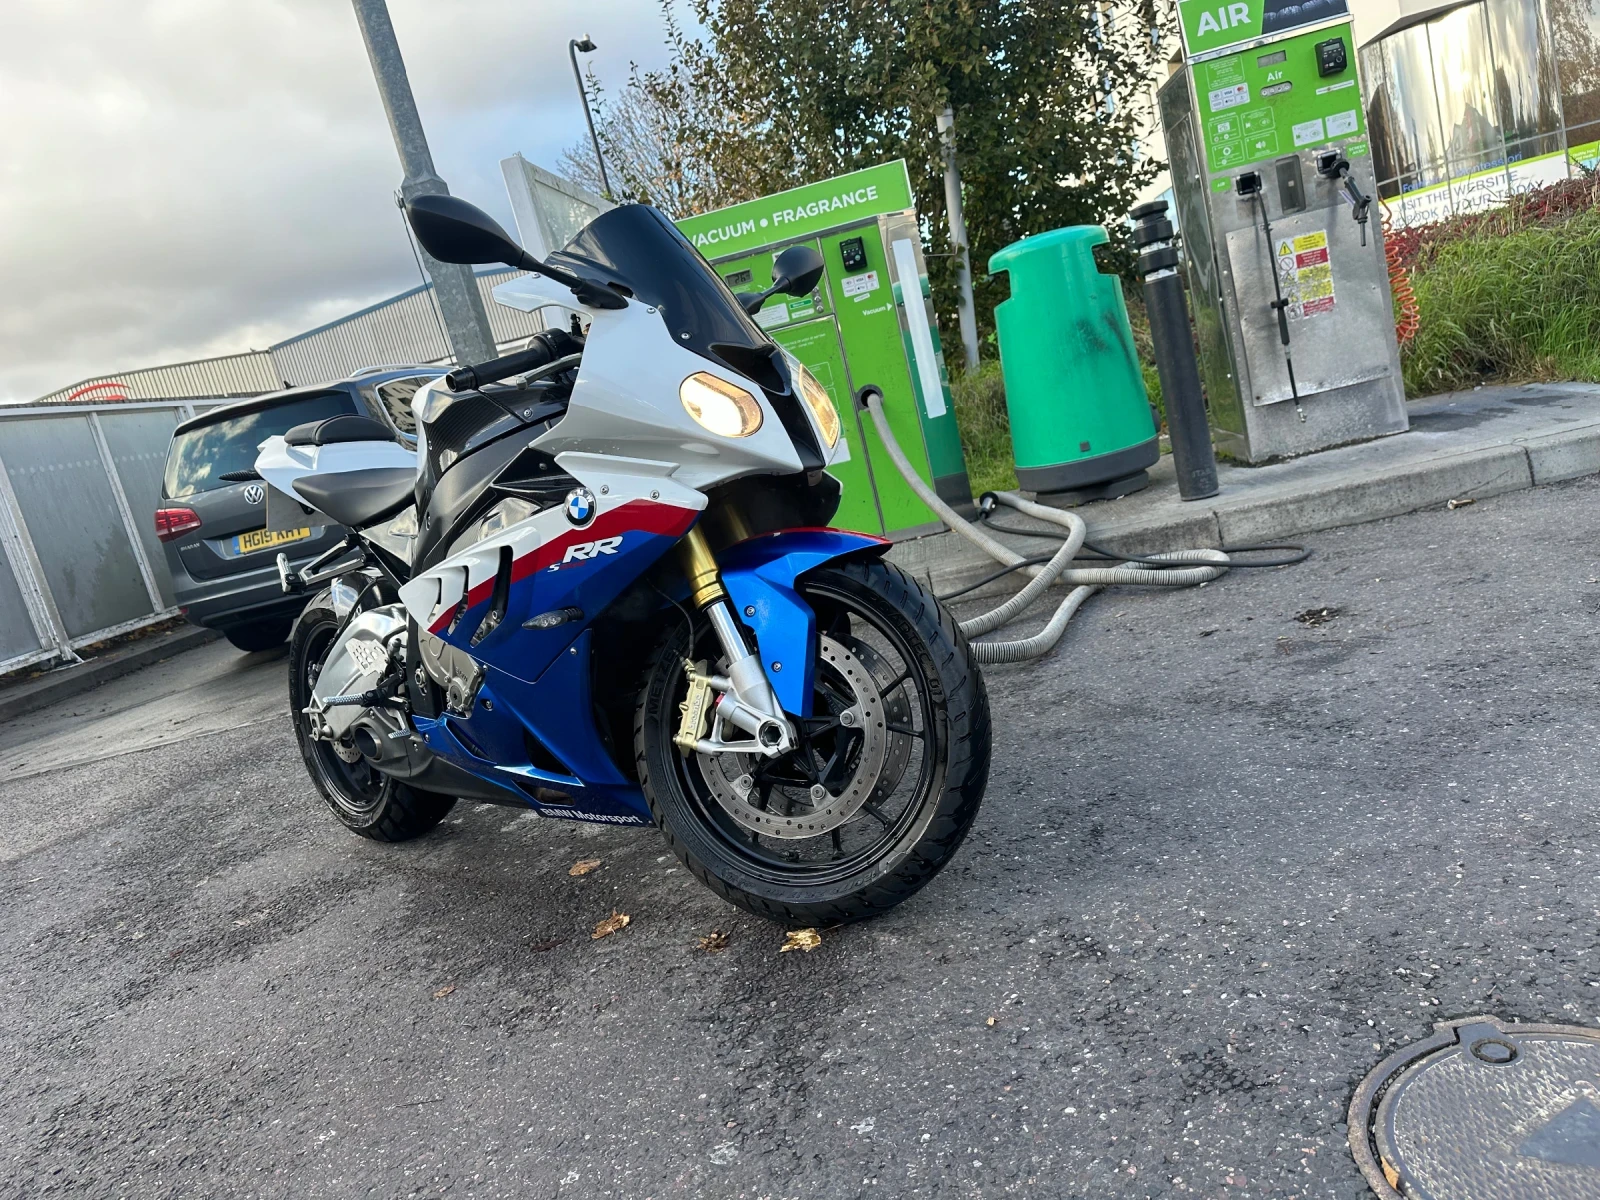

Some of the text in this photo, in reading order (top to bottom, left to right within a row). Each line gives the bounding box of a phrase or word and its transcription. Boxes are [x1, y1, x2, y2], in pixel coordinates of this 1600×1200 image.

[1197, 2, 1252, 37] AIR
[1266, 70, 1283, 82] Air
[1425, 189, 1450, 204] THE
[1453, 170, 1518, 196] WEBSITE
[689, 185, 879, 248] VACUUM FRAGRANCE
[1406, 207, 1438, 223] BOOK
[1442, 204, 1450, 215] A
[862, 305, 886, 316] Vacuum
[243, 530, 272, 549] HG19
[562, 536, 623, 563] RR
[687, 693, 702, 730] brembo
[573, 809, 644, 824] Motorsport
